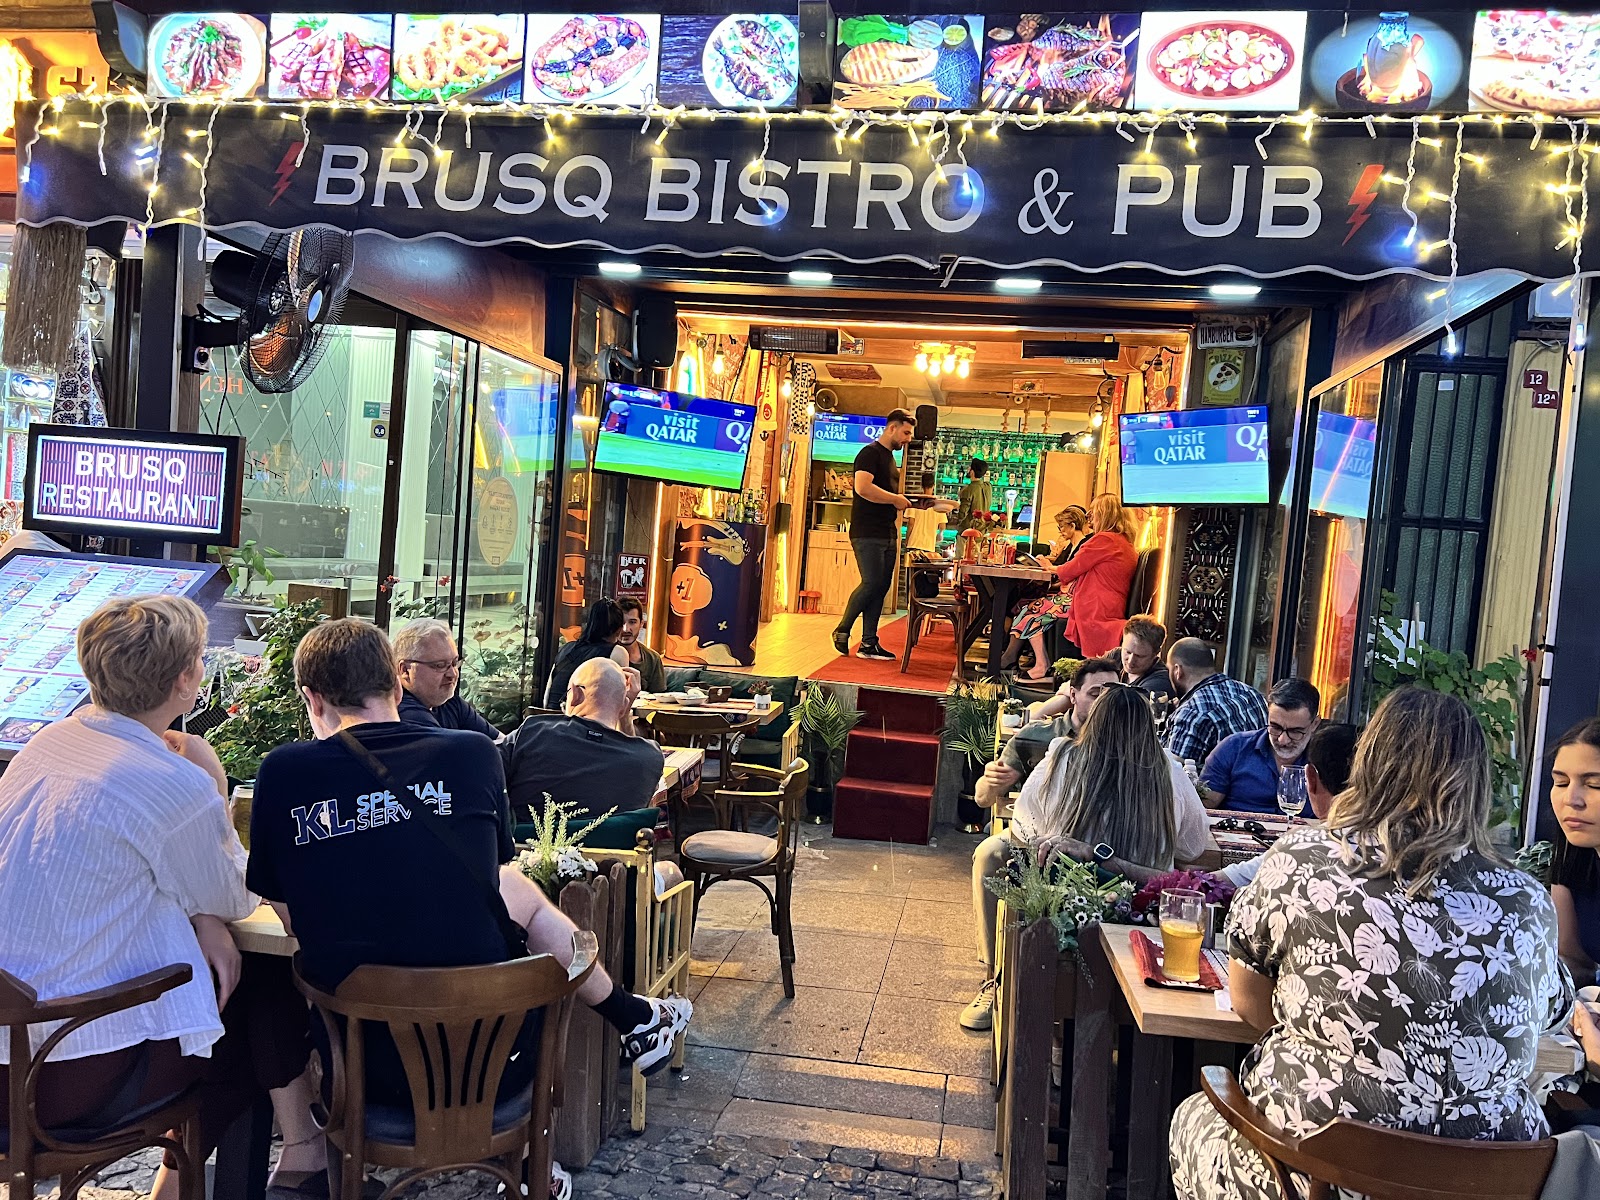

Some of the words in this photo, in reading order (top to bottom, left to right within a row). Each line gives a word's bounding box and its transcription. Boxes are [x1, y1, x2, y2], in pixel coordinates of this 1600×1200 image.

[313, 144, 613, 223] BRUSQ
[643, 157, 986, 233] BISTRO
[1017, 167, 1074, 235] &
[1111, 163, 1323, 239] PUB
[1200, 326, 1234, 345] HAMBURGER
[1529, 374, 1543, 385] 12
[663, 412, 700, 430] visit
[825, 423, 848, 433] visit
[645, 423, 697, 444] QATAR
[815, 430, 847, 441] QATAR
[1168, 429, 1206, 446] visit
[1154, 445, 1206, 465] QATAR
[74, 450, 187, 486] BRUSQ
[41, 481, 217, 520] RESTAURANT
[620, 556, 647, 567] BEER
[291, 798, 356, 846] KL
[356, 780, 452, 814] SPEIAL
[356, 797, 452, 831] SERVE
